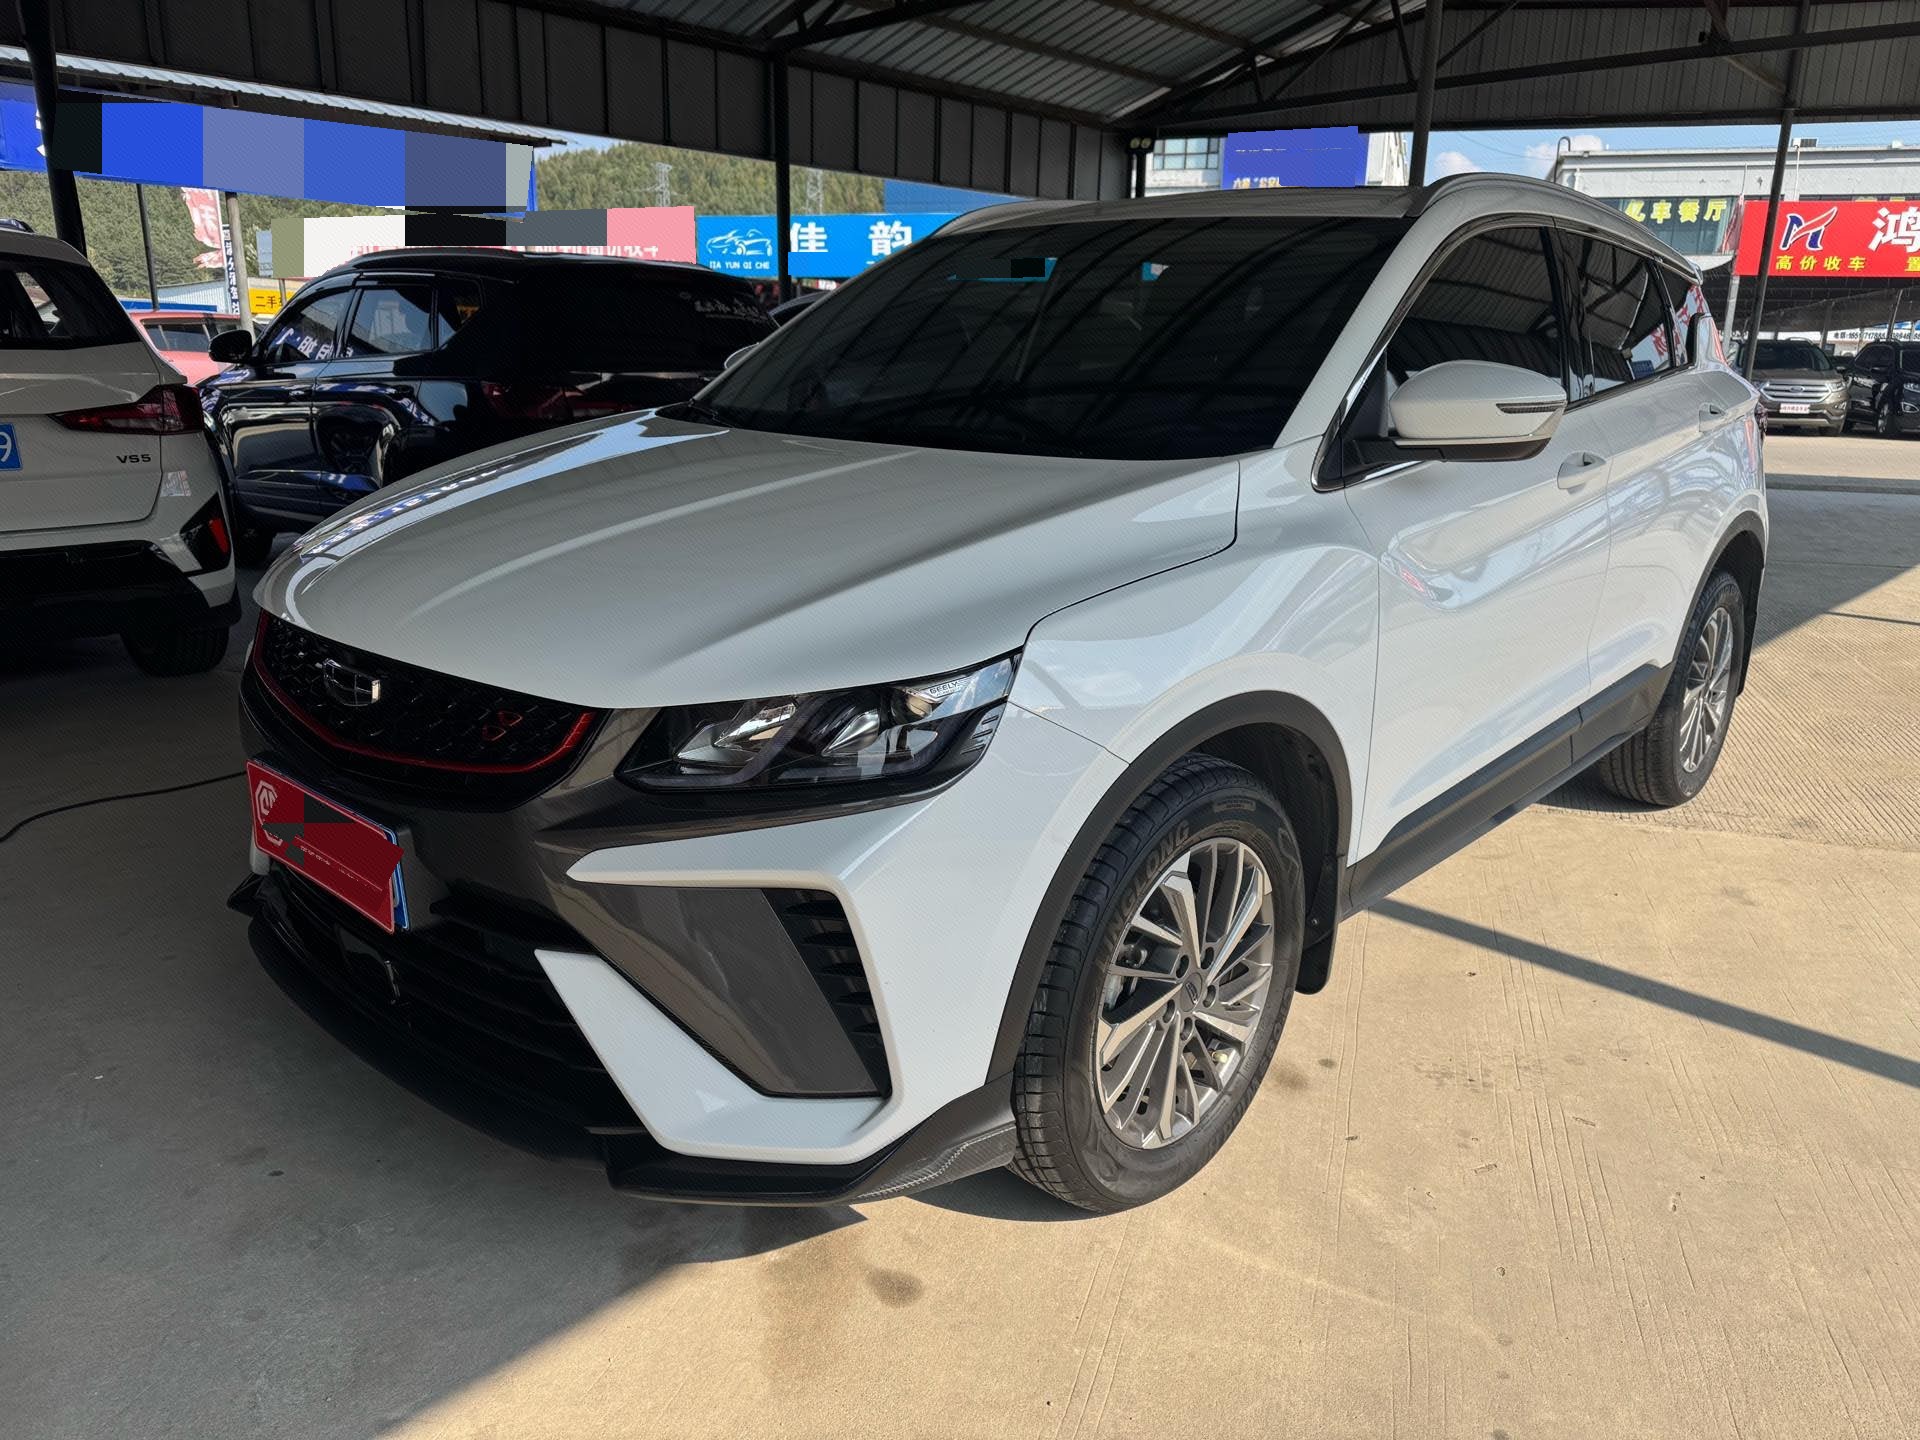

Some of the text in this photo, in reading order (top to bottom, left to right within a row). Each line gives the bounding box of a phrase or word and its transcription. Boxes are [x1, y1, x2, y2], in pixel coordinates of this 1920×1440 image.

[1868, 206, 1920, 252] 鸿
[725, 261, 740, 269] YUN
[755, 261, 770, 270] CHE
[1775, 255, 1865, 271] 高价收车
[116, 454, 152, 464] VS5
[929, 681, 958, 694] GEELY
